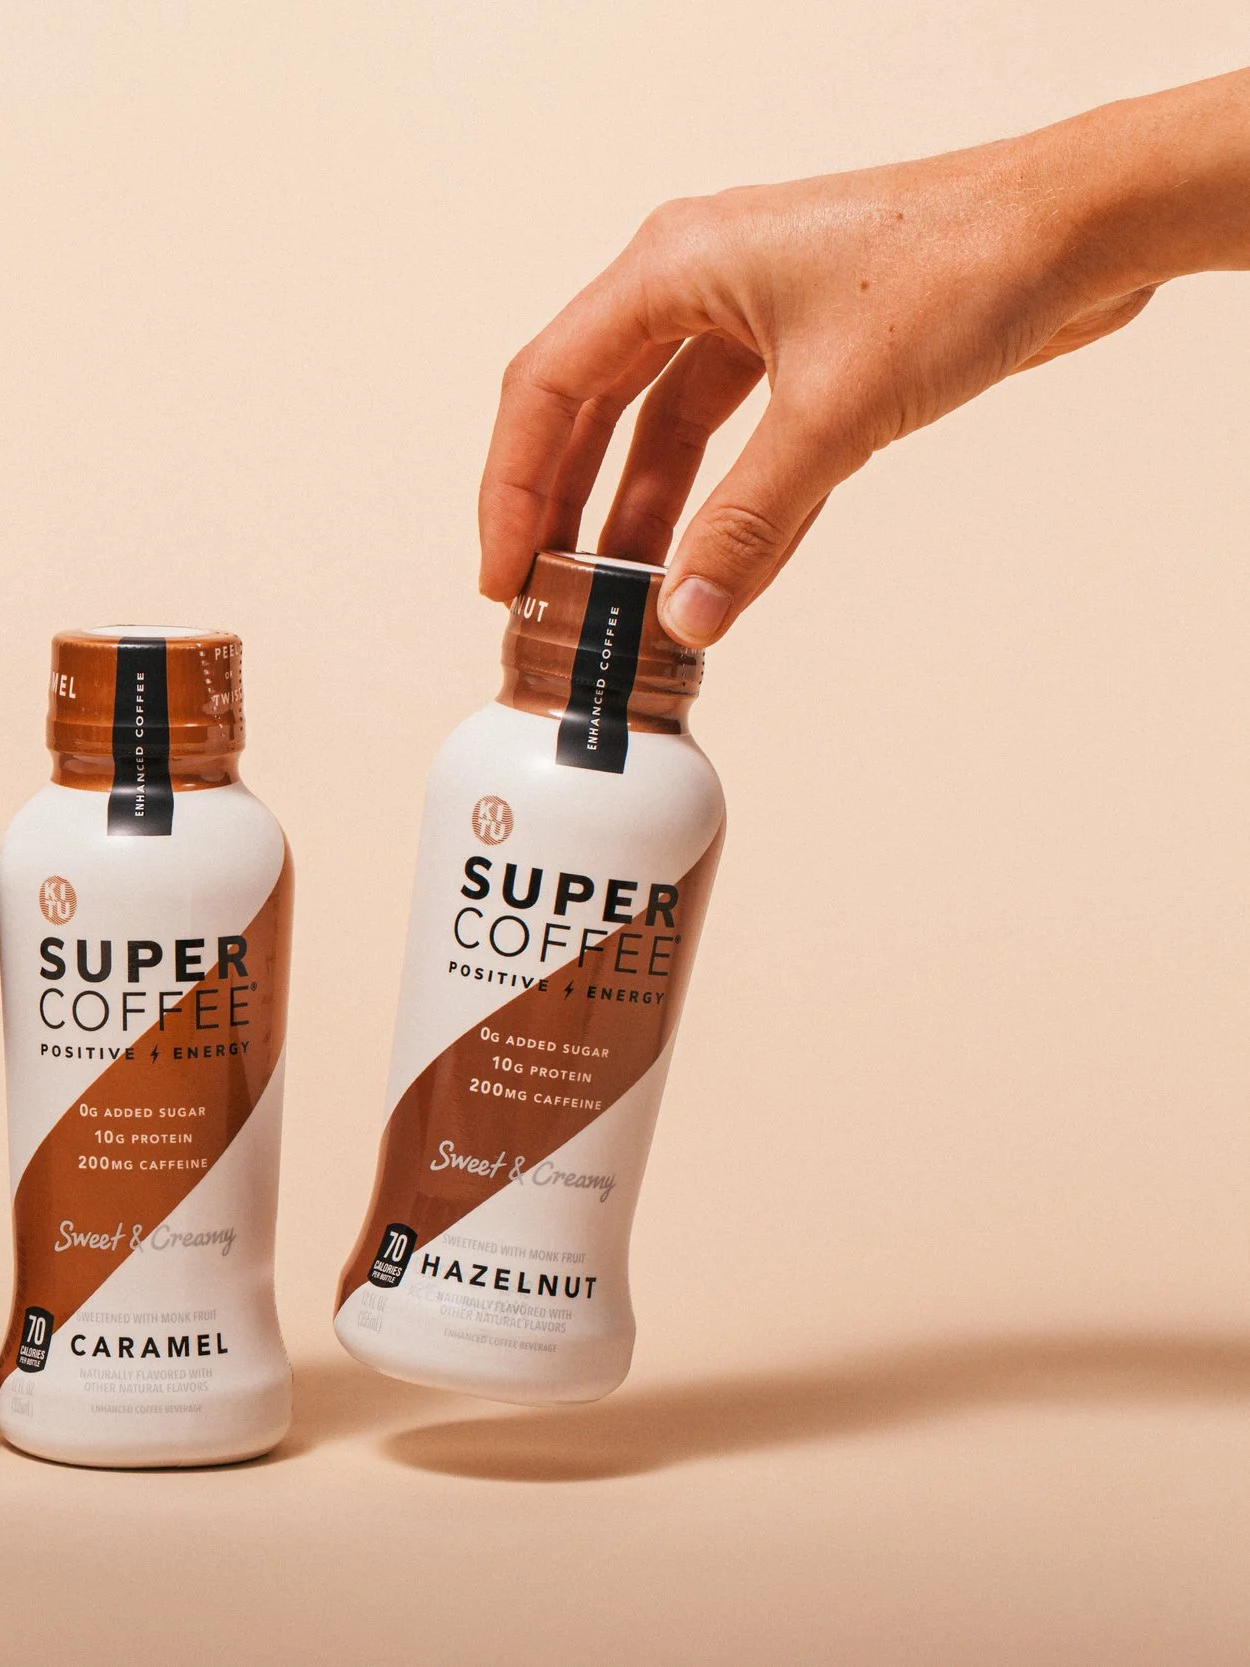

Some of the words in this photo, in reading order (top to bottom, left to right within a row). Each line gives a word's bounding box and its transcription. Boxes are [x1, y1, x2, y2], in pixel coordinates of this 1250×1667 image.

[587, 679, 606, 750] ENHANCED
[600, 606, 619, 671] COFFEE
[135, 672, 145, 738] COFFEE
[135, 746, 144, 817] ENHANCED
[461, 856, 679, 928] SUPER
[454, 907, 674, 976] COFFEE
[40, 935, 249, 983] SUPER
[449, 961, 549, 992] POSITIVE
[587, 986, 665, 1005] ENERGY
[40, 985, 249, 1031] COFFEE
[41, 1043, 134, 1060] POSITIVE
[174, 1041, 250, 1060] ENERGY
[480, 1027, 500, 1043] 0G
[506, 1036, 557, 1052] ADDED
[563, 1044, 610, 1058] SUGAR
[492, 1056, 524, 1074] 10G
[530, 1066, 592, 1083] PROTEIN
[469, 1078, 527, 1101] 200MG
[533, 1093, 602, 1111] CAFFEINE
[80, 1103, 98, 1117] 0G
[104, 1107, 153, 1118] ADDED
[159, 1106, 206, 1118] SUGAR
[94, 1130, 125, 1144] 10G
[132, 1133, 192, 1144] PROTEIN
[78, 1155, 133, 1170] 200MG
[139, 1159, 208, 1170] CAFFEINE
[430, 1140, 507, 1179] Sweet
[508, 1156, 526, 1186] &
[532, 1161, 617, 1203] Creamy
[54, 1220, 126, 1252] Sweet
[129, 1224, 144, 1252] &
[151, 1224, 236, 1256] Creamy
[383, 1231, 407, 1262] 70
[442, 1234, 498, 1254] SWEETENED
[500, 1245, 526, 1258] WITH
[529, 1249, 559, 1262] MONK
[561, 1252, 586, 1264] FRUIT
[374, 1260, 402, 1277] CALORIES
[421, 1253, 598, 1299] HAZELNUT
[76, 1311, 130, 1324] SWEETENED
[133, 1313, 158, 1324] WITH
[160, 1312, 191, 1324] MONK
[193, 1310, 217, 1321] FRUIT
[436, 1291, 494, 1310] NATURALLY
[495, 1300, 546, 1317] FLAVORED
[549, 1308, 572, 1320] WITH
[440, 1304, 472, 1320] OTHER
[475, 1311, 525, 1329] NATURAL
[525, 1320, 567, 1334] FLAVORS
[26, 1315, 46, 1345] 70
[20, 1345, 45, 1360] CALORIES
[71, 1332, 228, 1359] CARAMEL
[79, 1367, 134, 1381] NATURALLY
[136, 1369, 186, 1381] FLAVORED
[188, 1367, 213, 1379] WITH
[84, 1380, 116, 1393] OTHER
[119, 1382, 163, 1394] NATURAL
[166, 1380, 209, 1393] FLAVORS
